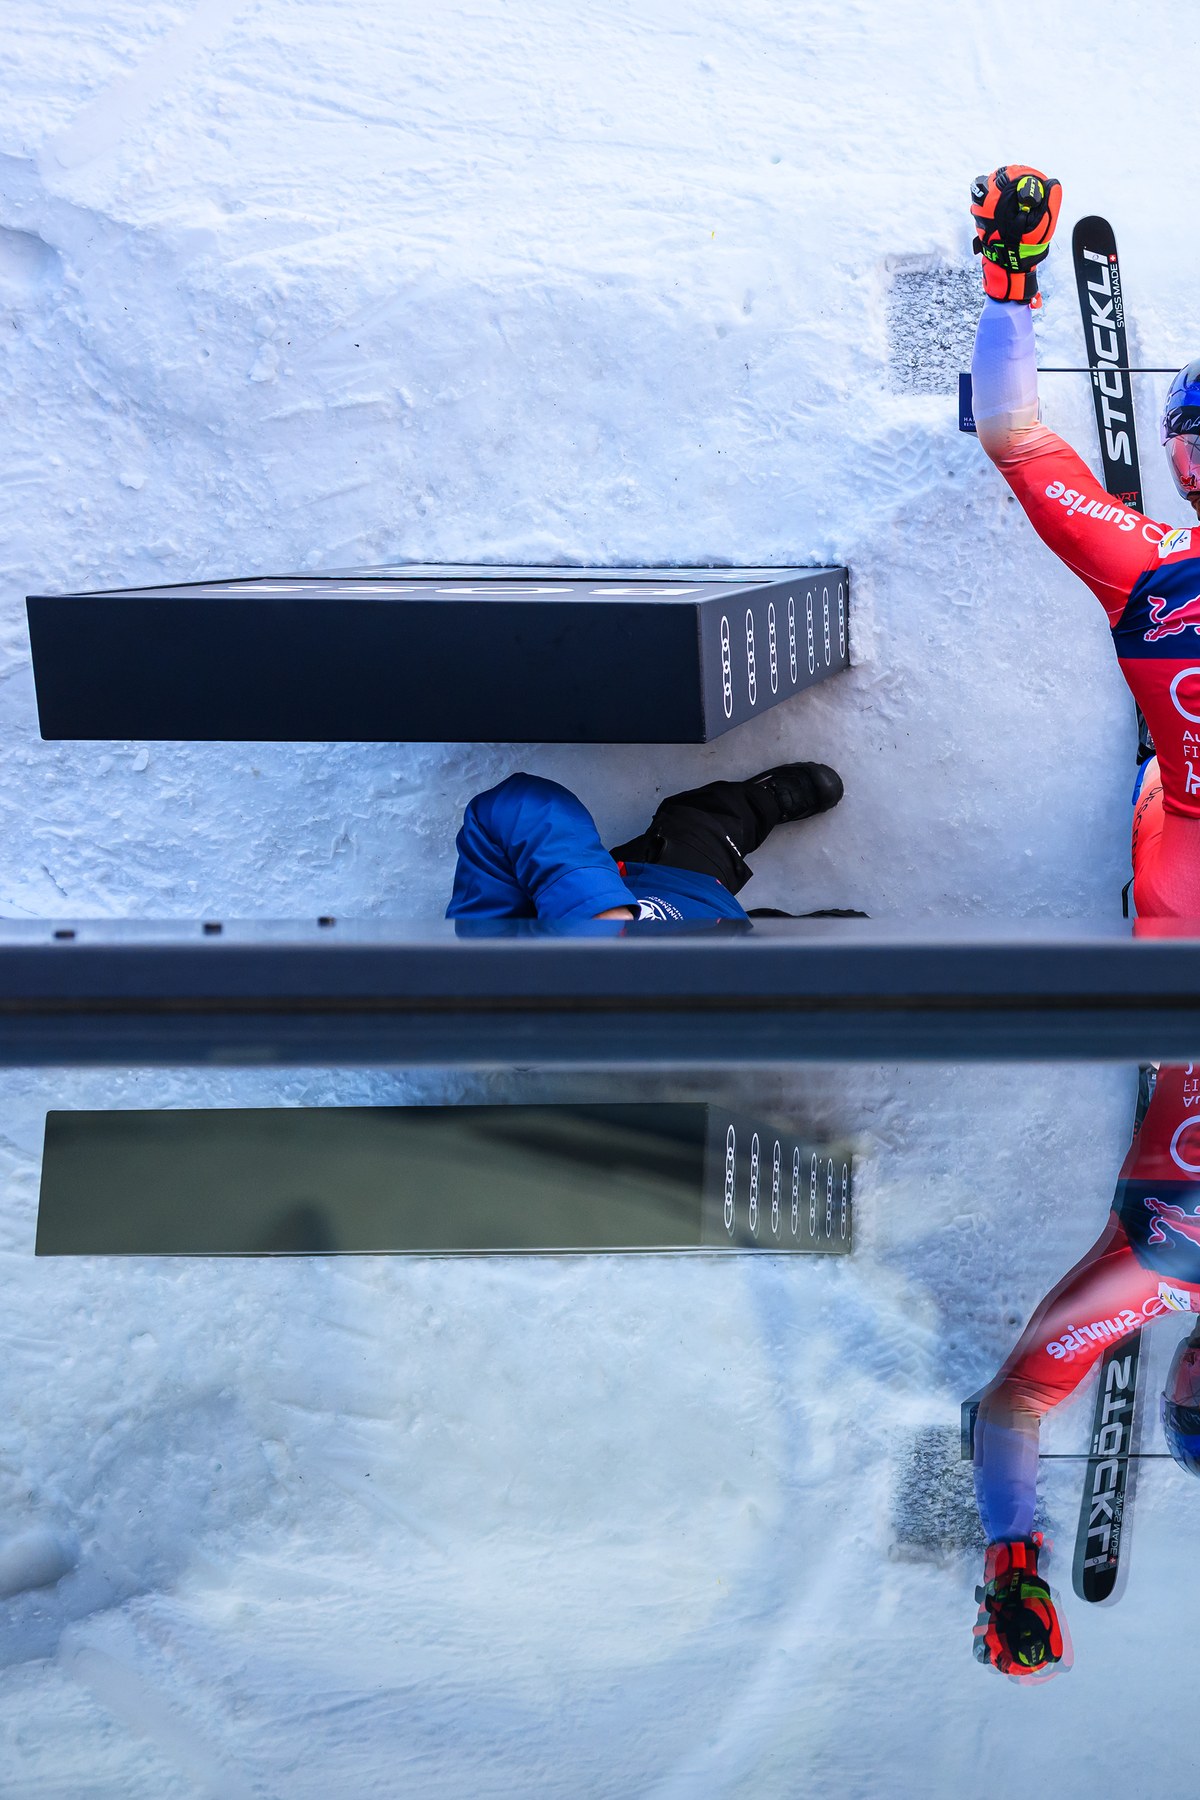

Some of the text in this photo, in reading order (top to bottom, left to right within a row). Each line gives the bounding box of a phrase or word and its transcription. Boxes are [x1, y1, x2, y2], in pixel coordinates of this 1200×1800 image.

[1008, 250, 1019, 270] LEKI
[1110, 263, 1125, 328] SWISS MADE
